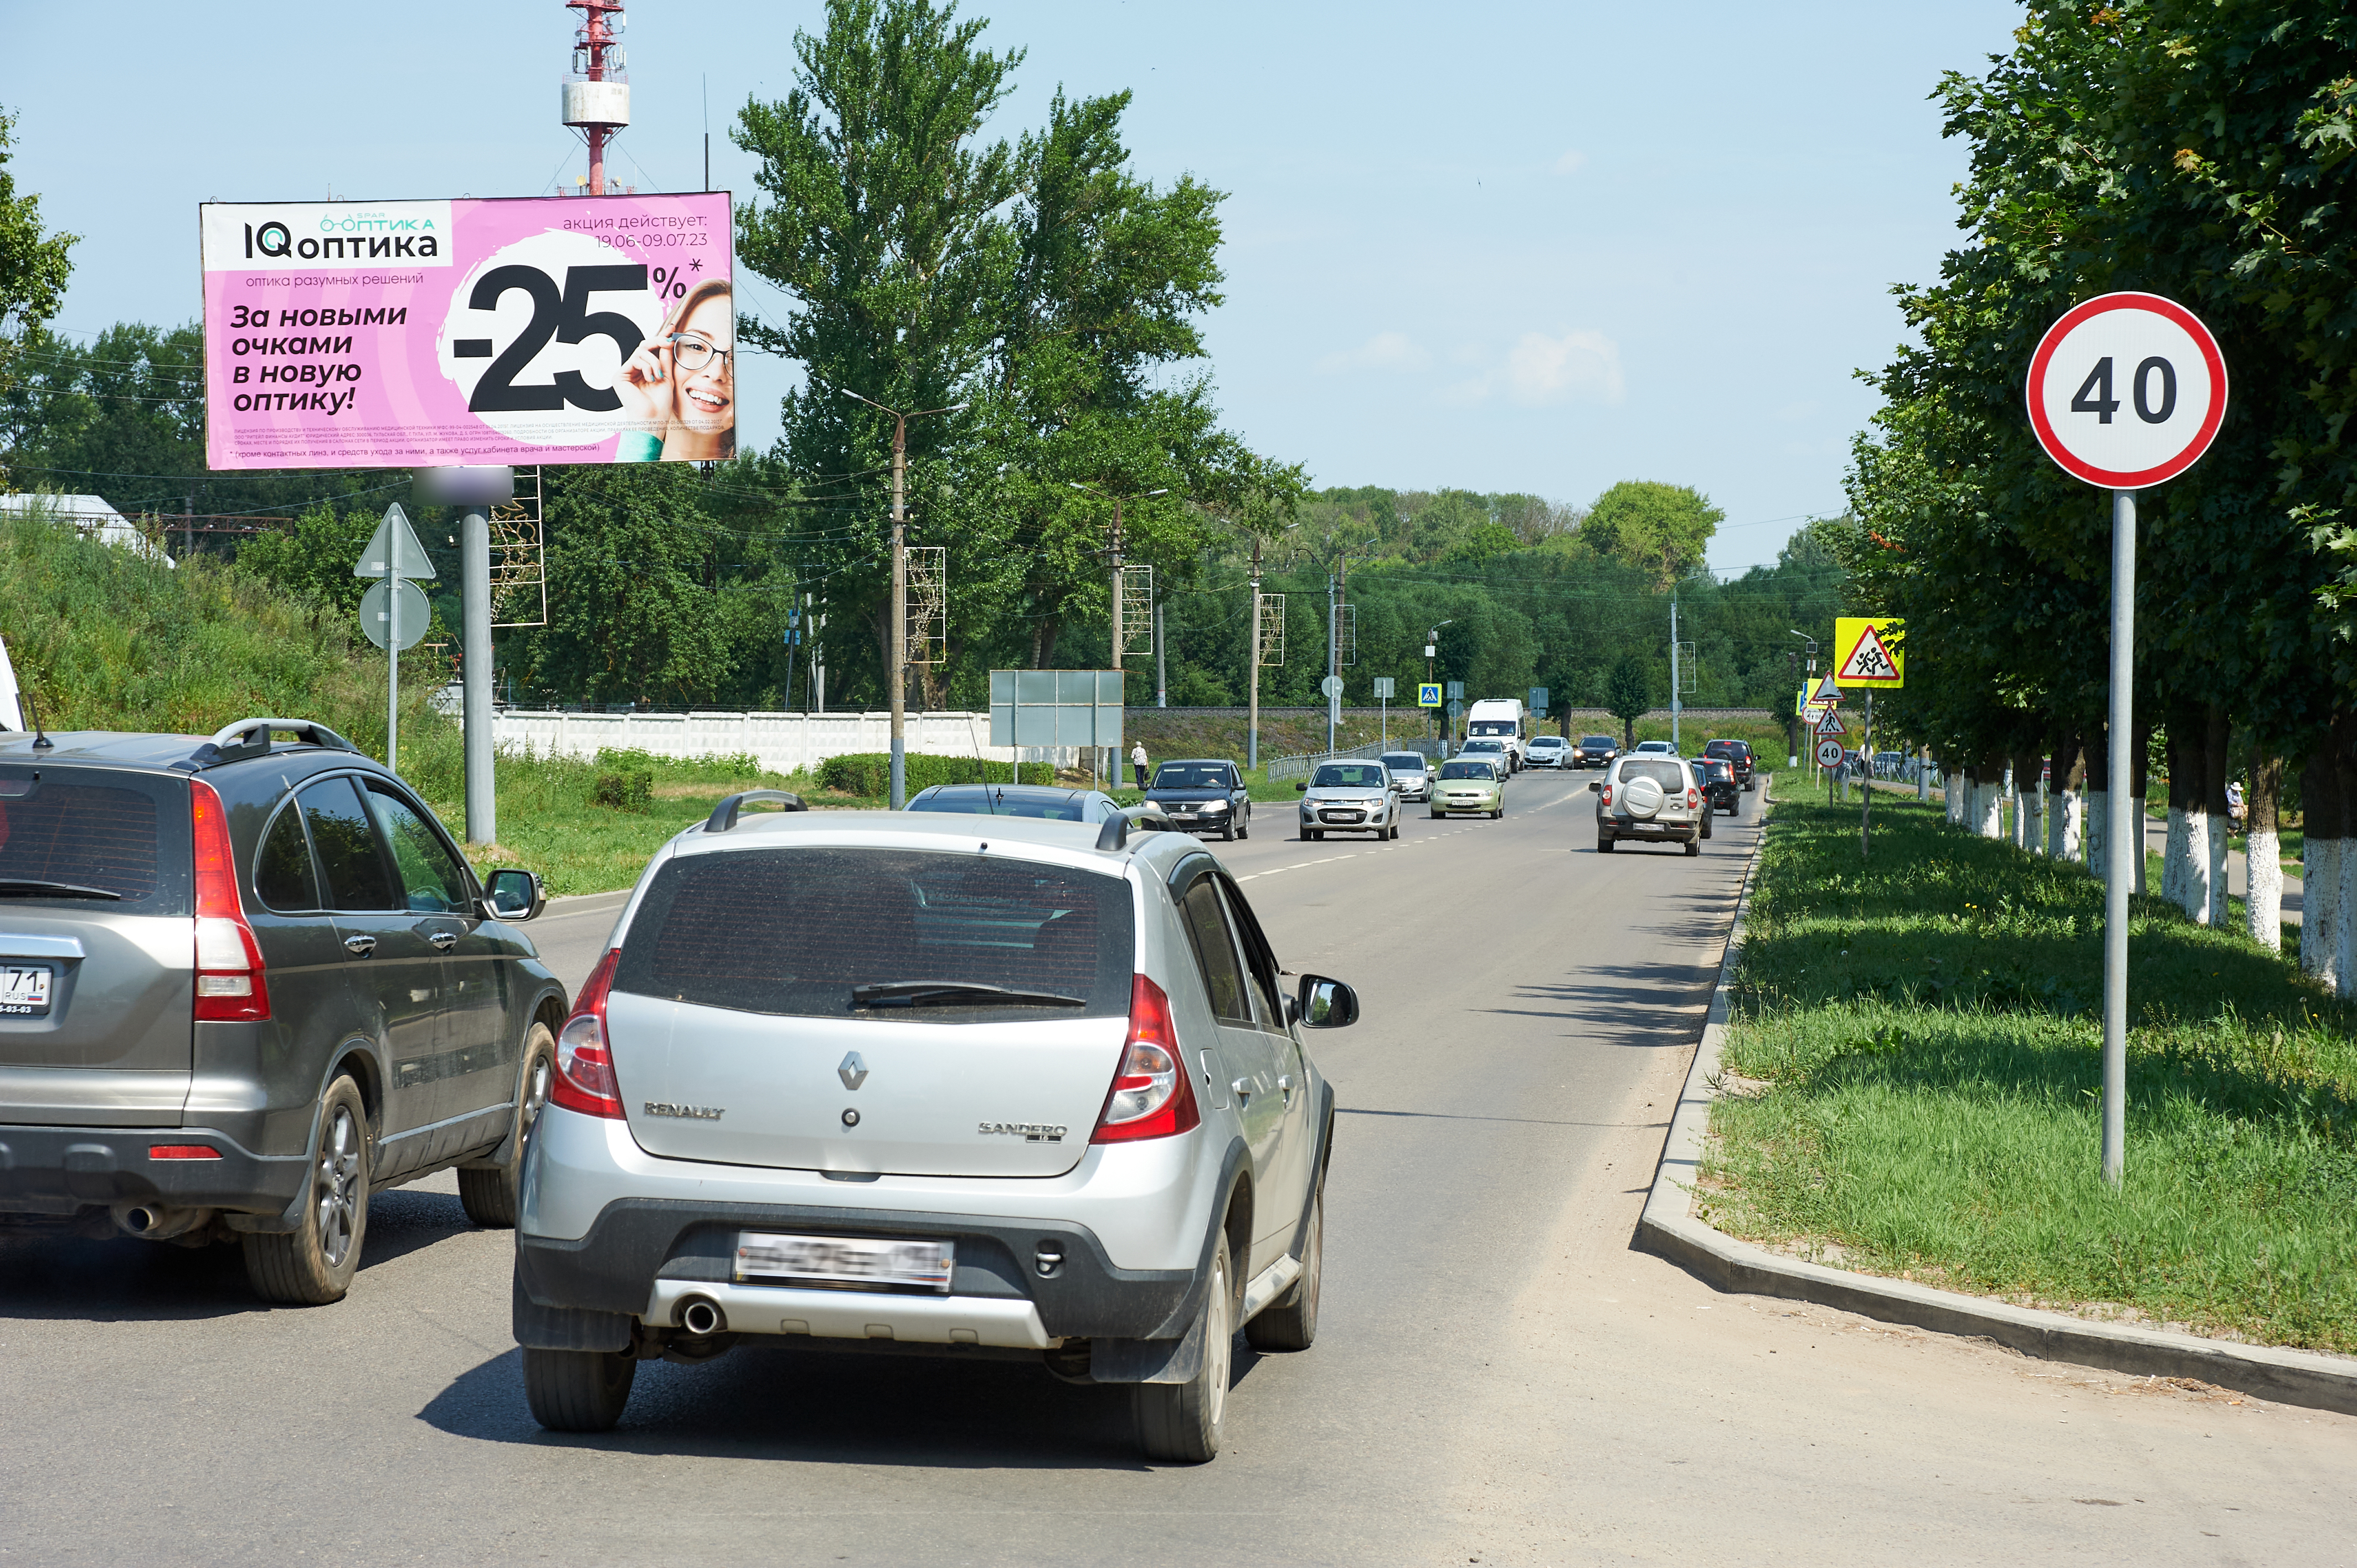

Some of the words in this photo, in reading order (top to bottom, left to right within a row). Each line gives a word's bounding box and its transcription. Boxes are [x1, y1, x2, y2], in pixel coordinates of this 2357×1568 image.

[563, 217, 614, 231] акция
[619, 214, 707, 229] действует:
[595, 233, 707, 247] 19.06-09.07.23
[246, 277, 290, 287] оптика
[294, 276, 358, 288] разумных
[362, 272, 423, 287] решений
[230, 306, 269, 328] За
[280, 307, 406, 327] новыми
[231, 336, 353, 355] очками
[233, 366, 249, 383] в
[260, 364, 361, 388] новую
[2071, 356, 2176, 424] 40
[234, 388, 356, 415] оптику!
[235, 450, 261, 459] (кроме
[552, 443, 599, 452] мастерской)
[1822, 747, 1838, 759] 40
[10, 970, 38, 992] 71
[645, 1102, 726, 1120] RENAULT
[979, 1121, 1068, 1136] SANDERO
